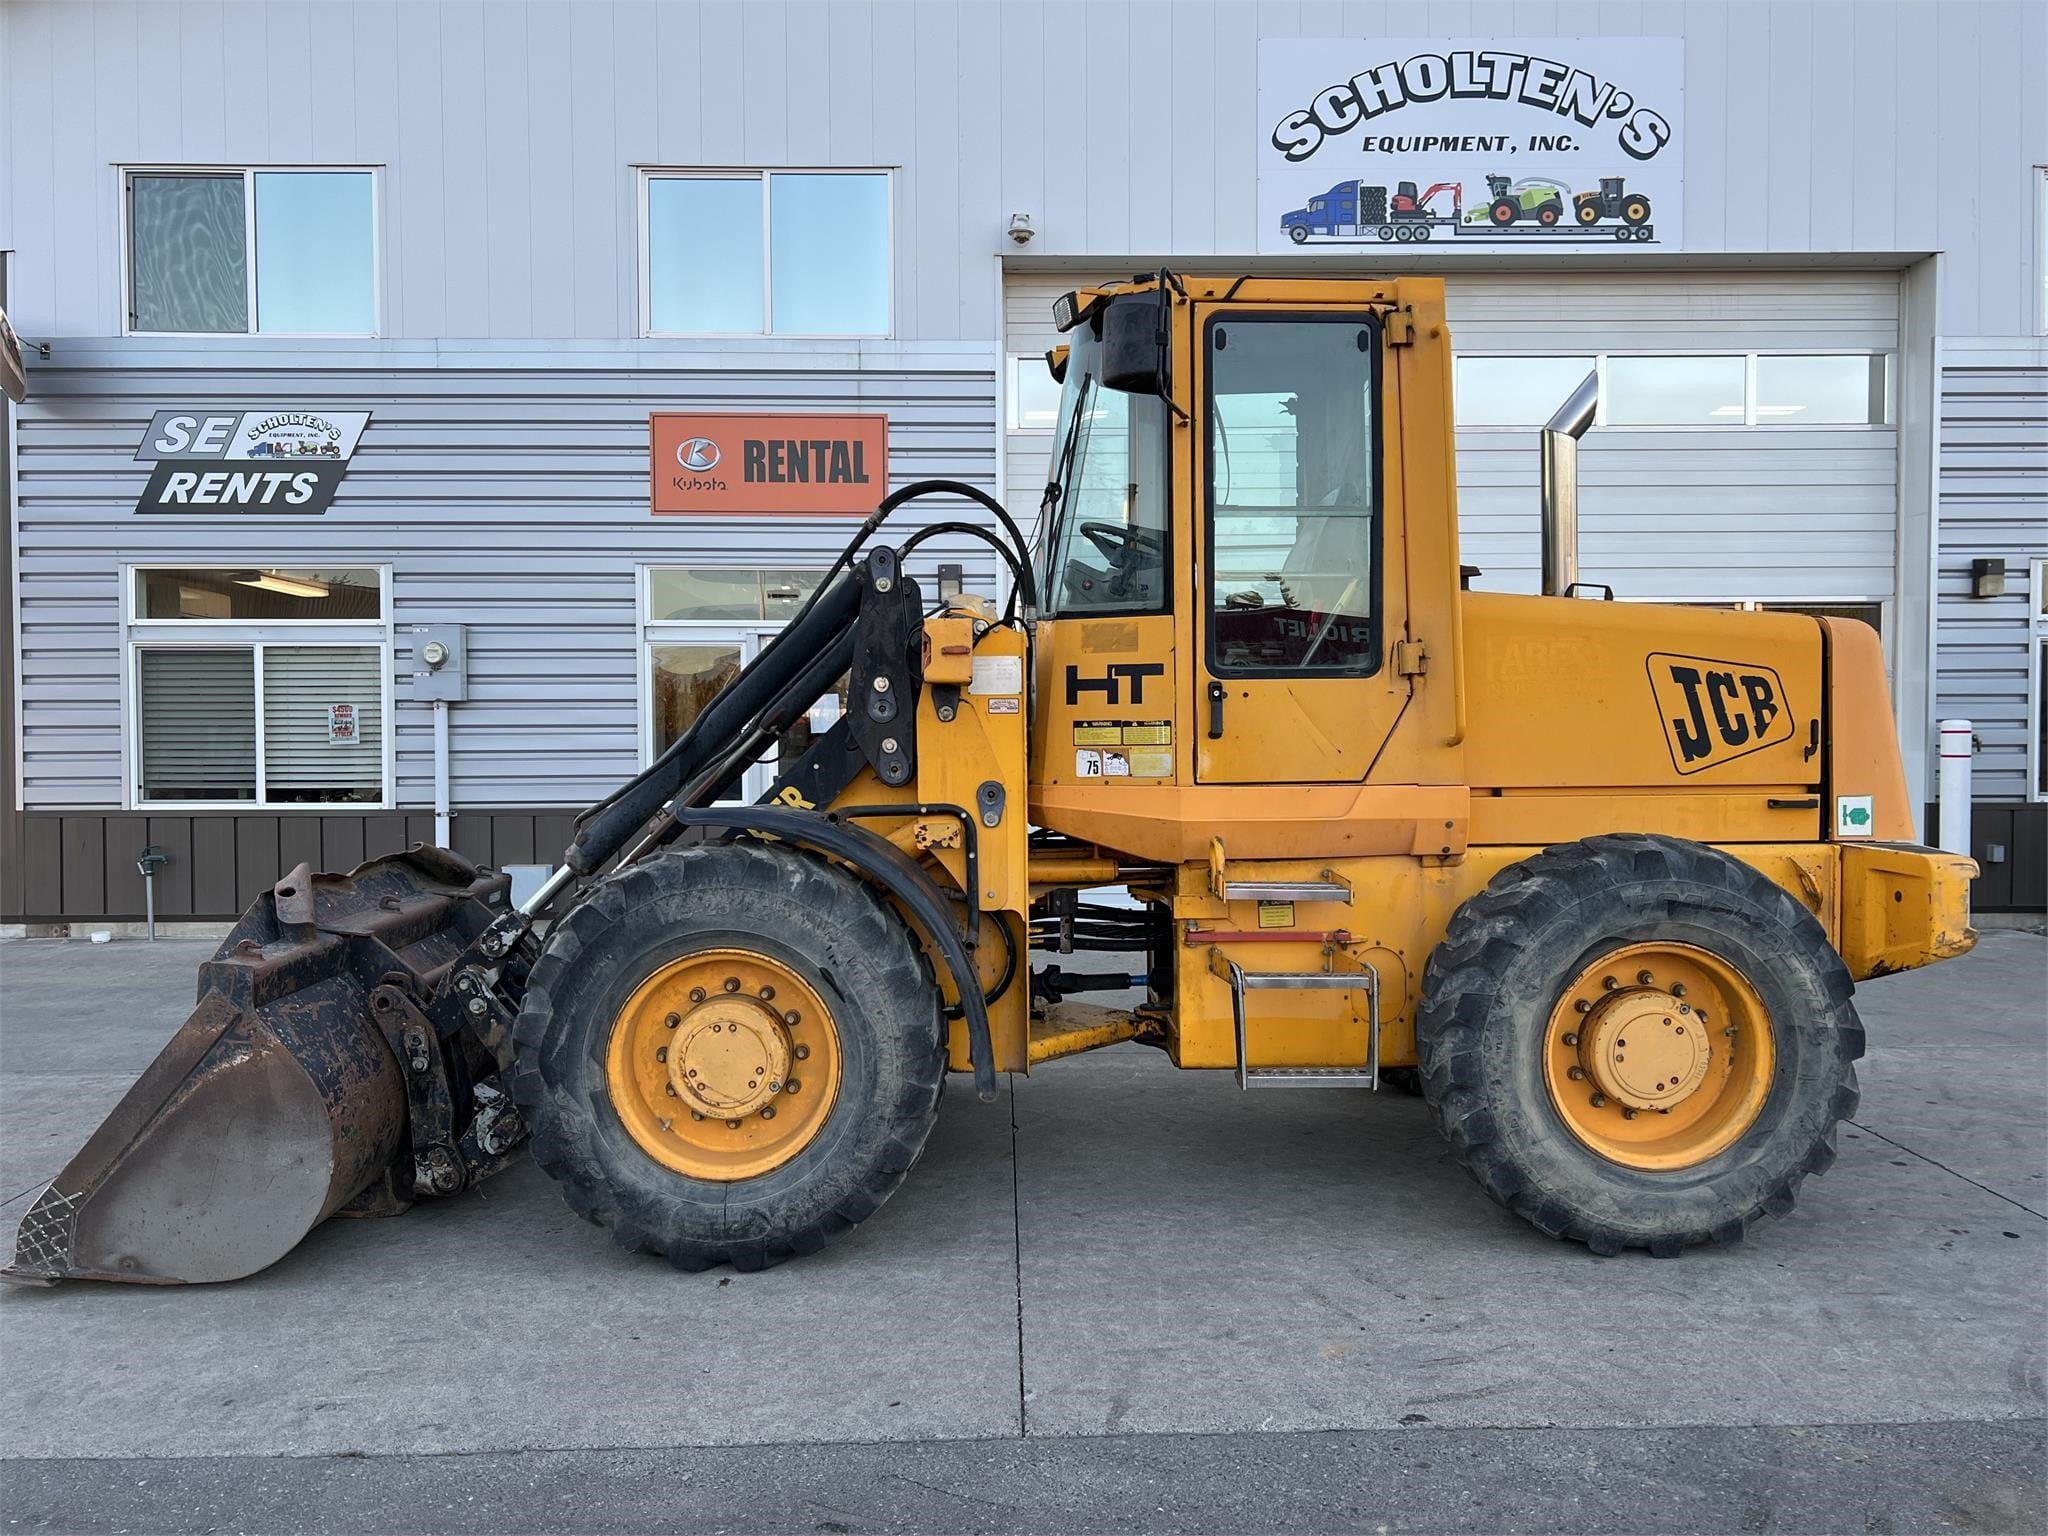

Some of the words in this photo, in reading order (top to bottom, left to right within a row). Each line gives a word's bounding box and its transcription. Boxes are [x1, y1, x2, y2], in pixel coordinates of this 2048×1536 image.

[1272, 50, 1671, 162] SCHOLTEN'S
[1362, 136, 1518, 154] EQUIPMENT,
[1529, 135, 1580, 152] INC.
[154, 416, 236, 453] SE
[247, 413, 341, 440] SCHOLTEN'S
[743, 440, 869, 484] RENTAL
[158, 472, 318, 504] RENTS
[673, 477, 727, 491] Kubota
[1066, 663, 1164, 705] HT
[1670, 665, 1778, 762] JCB
[1087, 760, 1099, 775] 75
